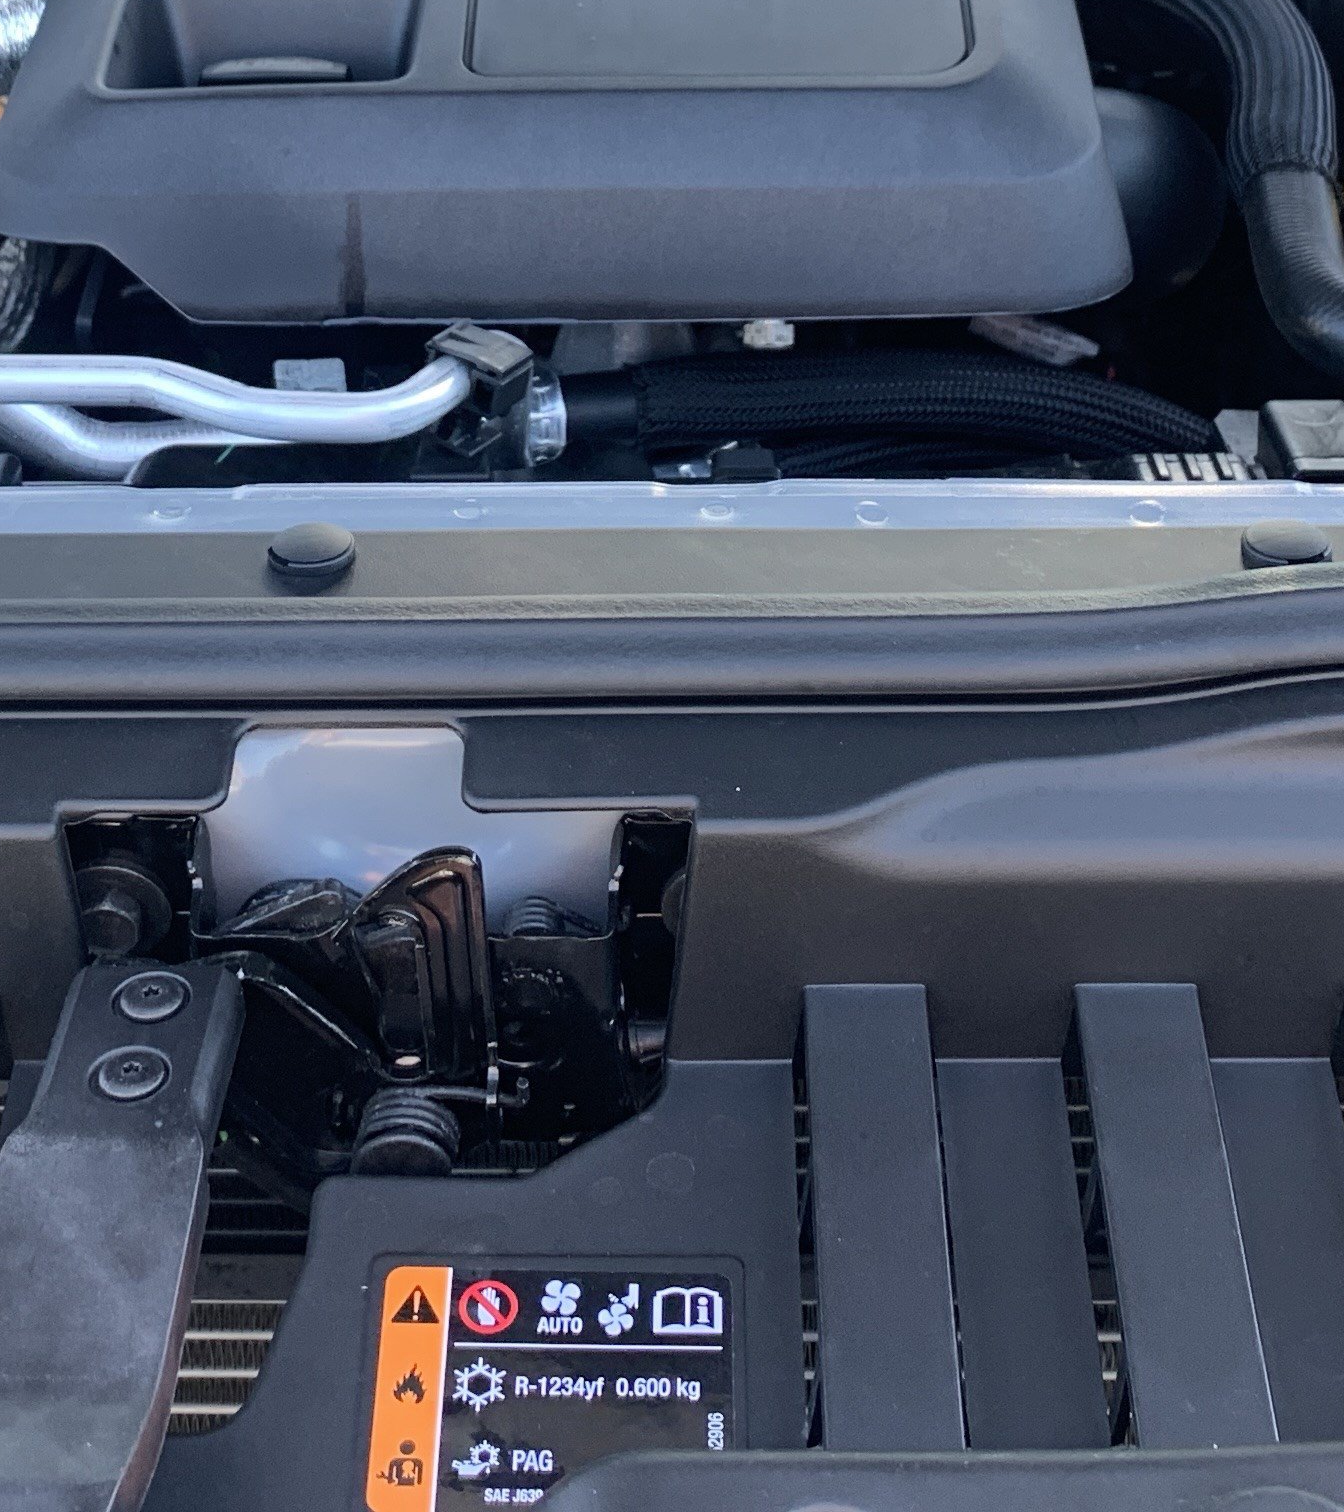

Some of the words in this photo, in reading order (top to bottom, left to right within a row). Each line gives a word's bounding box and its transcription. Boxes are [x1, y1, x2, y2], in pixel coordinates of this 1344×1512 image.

[537, 1316, 583, 1335] AUTO
[515, 1376, 605, 1401] R-1234yf
[616, 1377, 671, 1397] 0.600
[676, 1378, 701, 1402] kg
[511, 1449, 554, 1472] PAG
[484, 1487, 511, 1503] SAE
